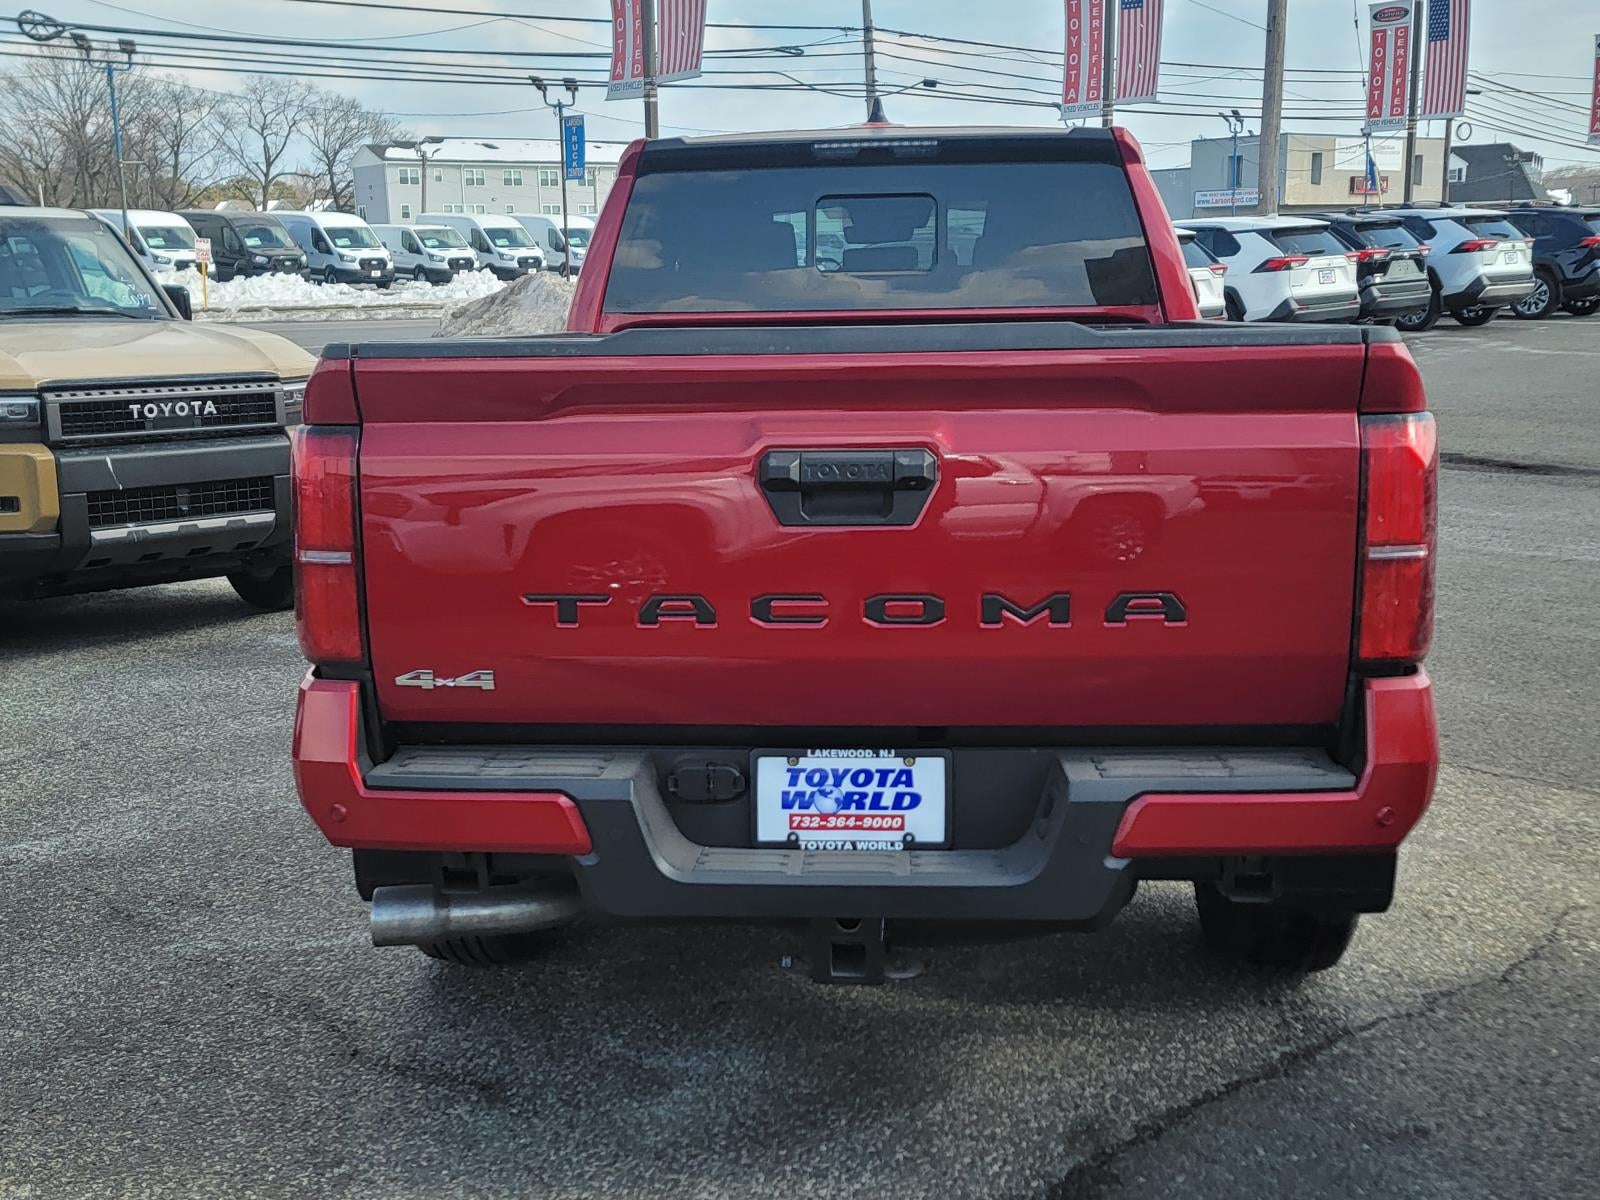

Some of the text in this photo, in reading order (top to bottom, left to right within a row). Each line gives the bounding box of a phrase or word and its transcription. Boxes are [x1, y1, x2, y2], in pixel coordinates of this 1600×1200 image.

[1067, 0, 1079, 100] TOYOTA
[1371, 32, 1384, 116] TOYOTA
[1393, 28, 1405, 114] CERTIFIED
[1381, 117, 1404, 126] VEHICLES
[129, 400, 218, 419] TOYOTA
[804, 463, 888, 479] TOYOTA
[519, 592, 1188, 629] TACOMA
[393, 669, 496, 691] 4x4
[879, 748, 896, 758] NJ
[786, 767, 914, 788] TOYOTA
[792, 816, 903, 829] 732-364-9000
[798, 841, 904, 851] TOYOTA WORLD
